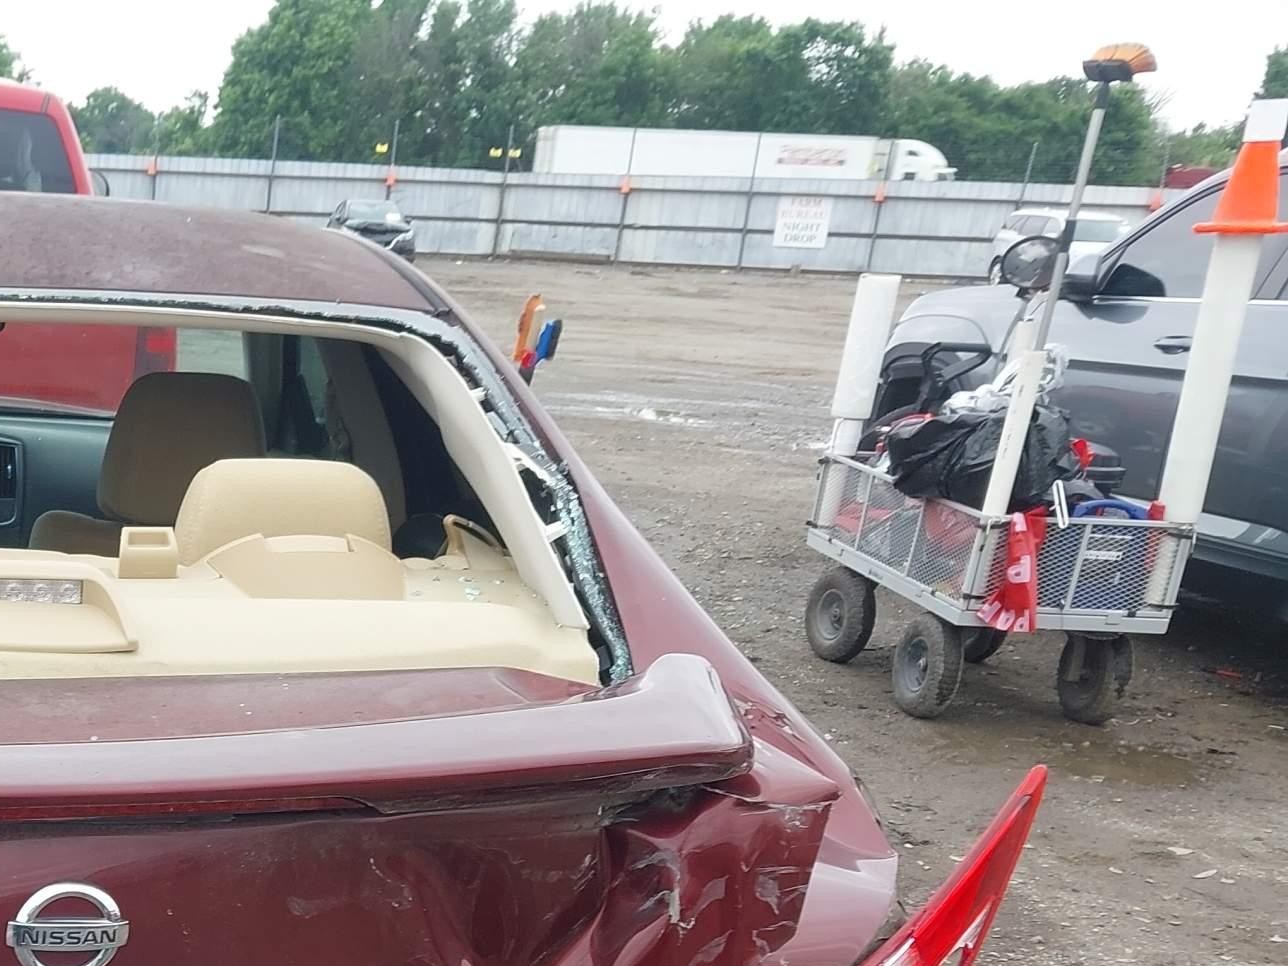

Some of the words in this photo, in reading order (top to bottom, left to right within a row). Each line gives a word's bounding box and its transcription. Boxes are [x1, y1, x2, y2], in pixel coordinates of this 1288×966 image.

[783, 221, 822, 232] NIGHT
[783, 233, 817, 243] DROP
[20, 928, 118, 945] NISSAN
